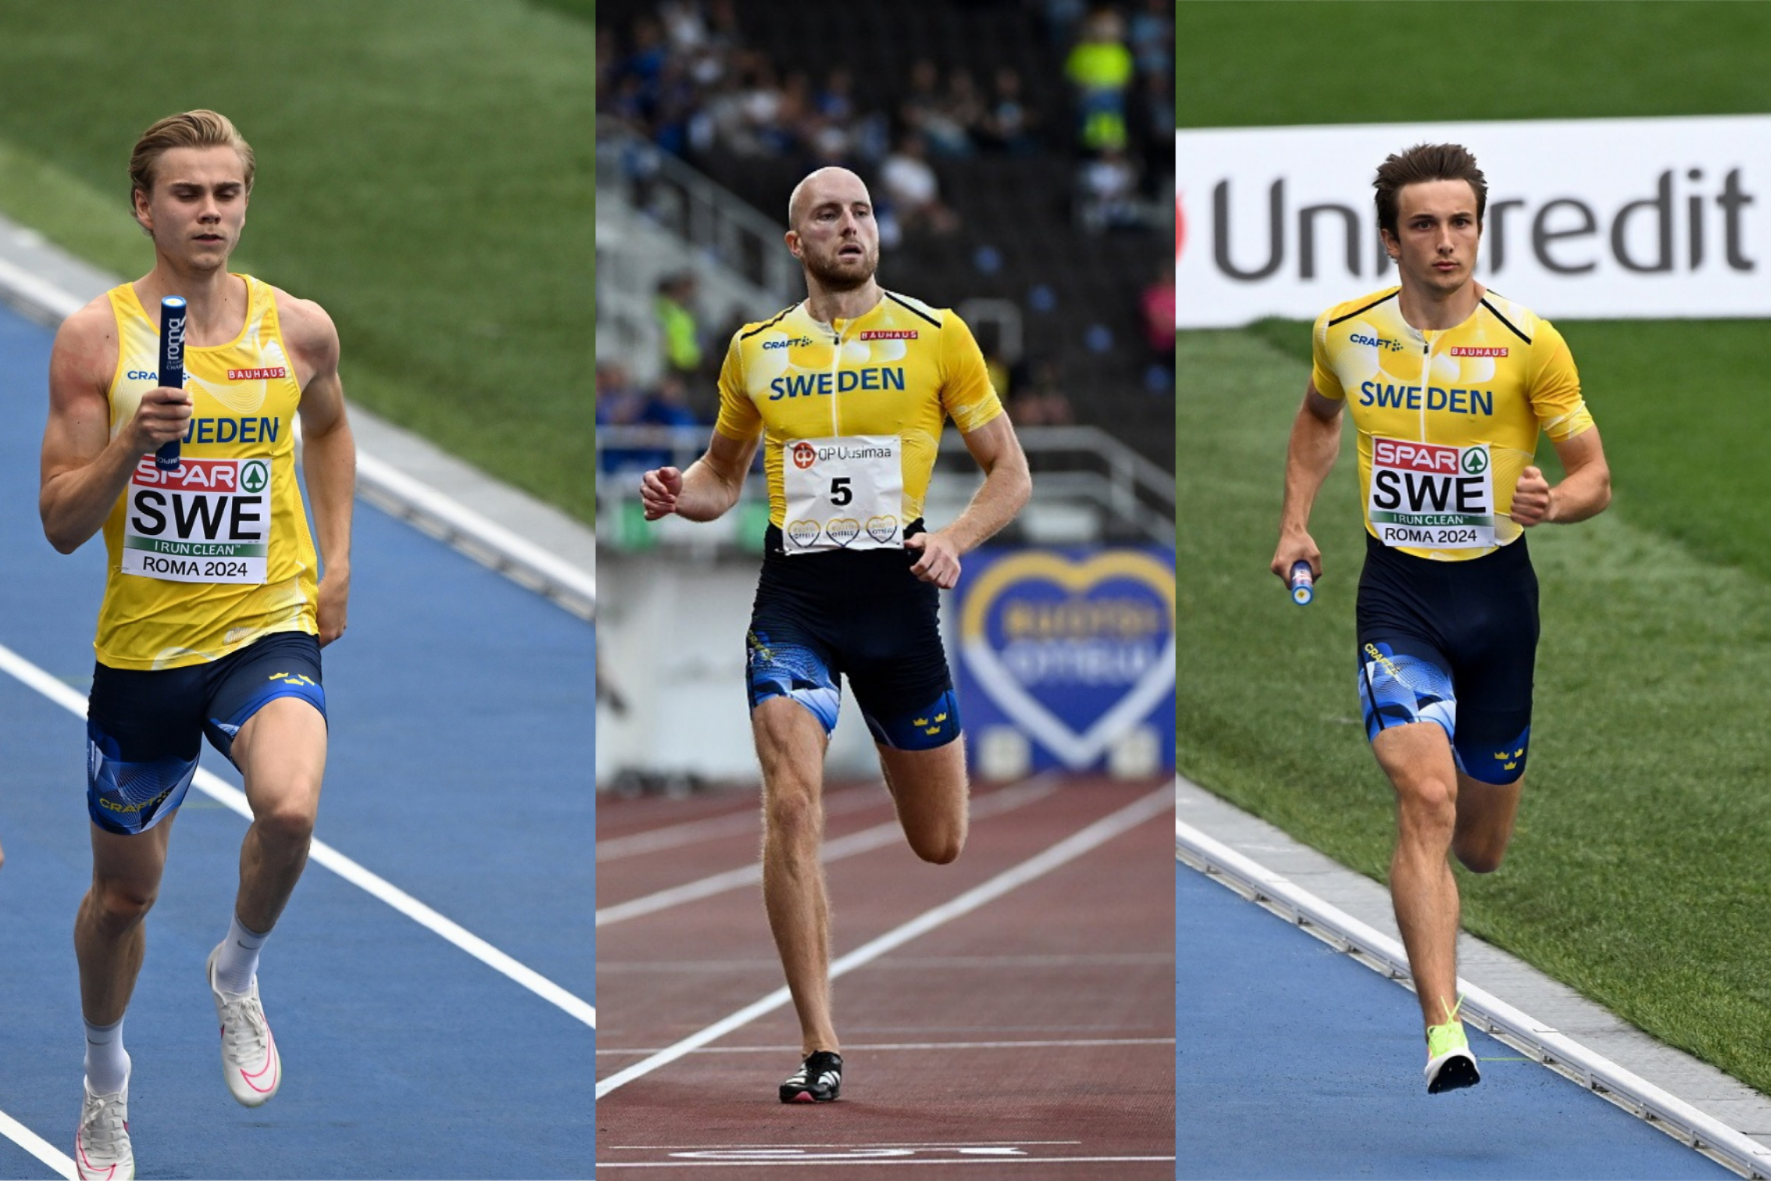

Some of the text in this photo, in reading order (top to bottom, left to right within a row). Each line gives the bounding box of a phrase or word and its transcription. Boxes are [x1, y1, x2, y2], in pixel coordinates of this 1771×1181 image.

[762, 338, 802, 350] CRAFT
[861, 331, 918, 340] BAUHAUS
[1349, 333, 1392, 350] CRAFT
[1451, 347, 1508, 357] BAUHAUS
[127, 370, 159, 380] CRA
[228, 368, 285, 380] BAUHAUS
[769, 367, 906, 401] SWEDEN
[1359, 381, 1493, 416] SWEDEN
[1376, 442, 1457, 471] SPAR
[136, 460, 236, 489] SPAR
[830, 477, 853, 506] 5
[1373, 470, 1487, 513] SWE
[131, 489, 263, 541] SWE
[1393, 513, 1397, 522] I
[1399, 514, 1423, 525] RUN
[1384, 527, 1477, 544] ROMA 2024
[154, 540, 158, 551] I
[160, 541, 190, 554] RUN
[142, 556, 248, 577] ROMA 2024
[99, 797, 157, 814] CRAFT
